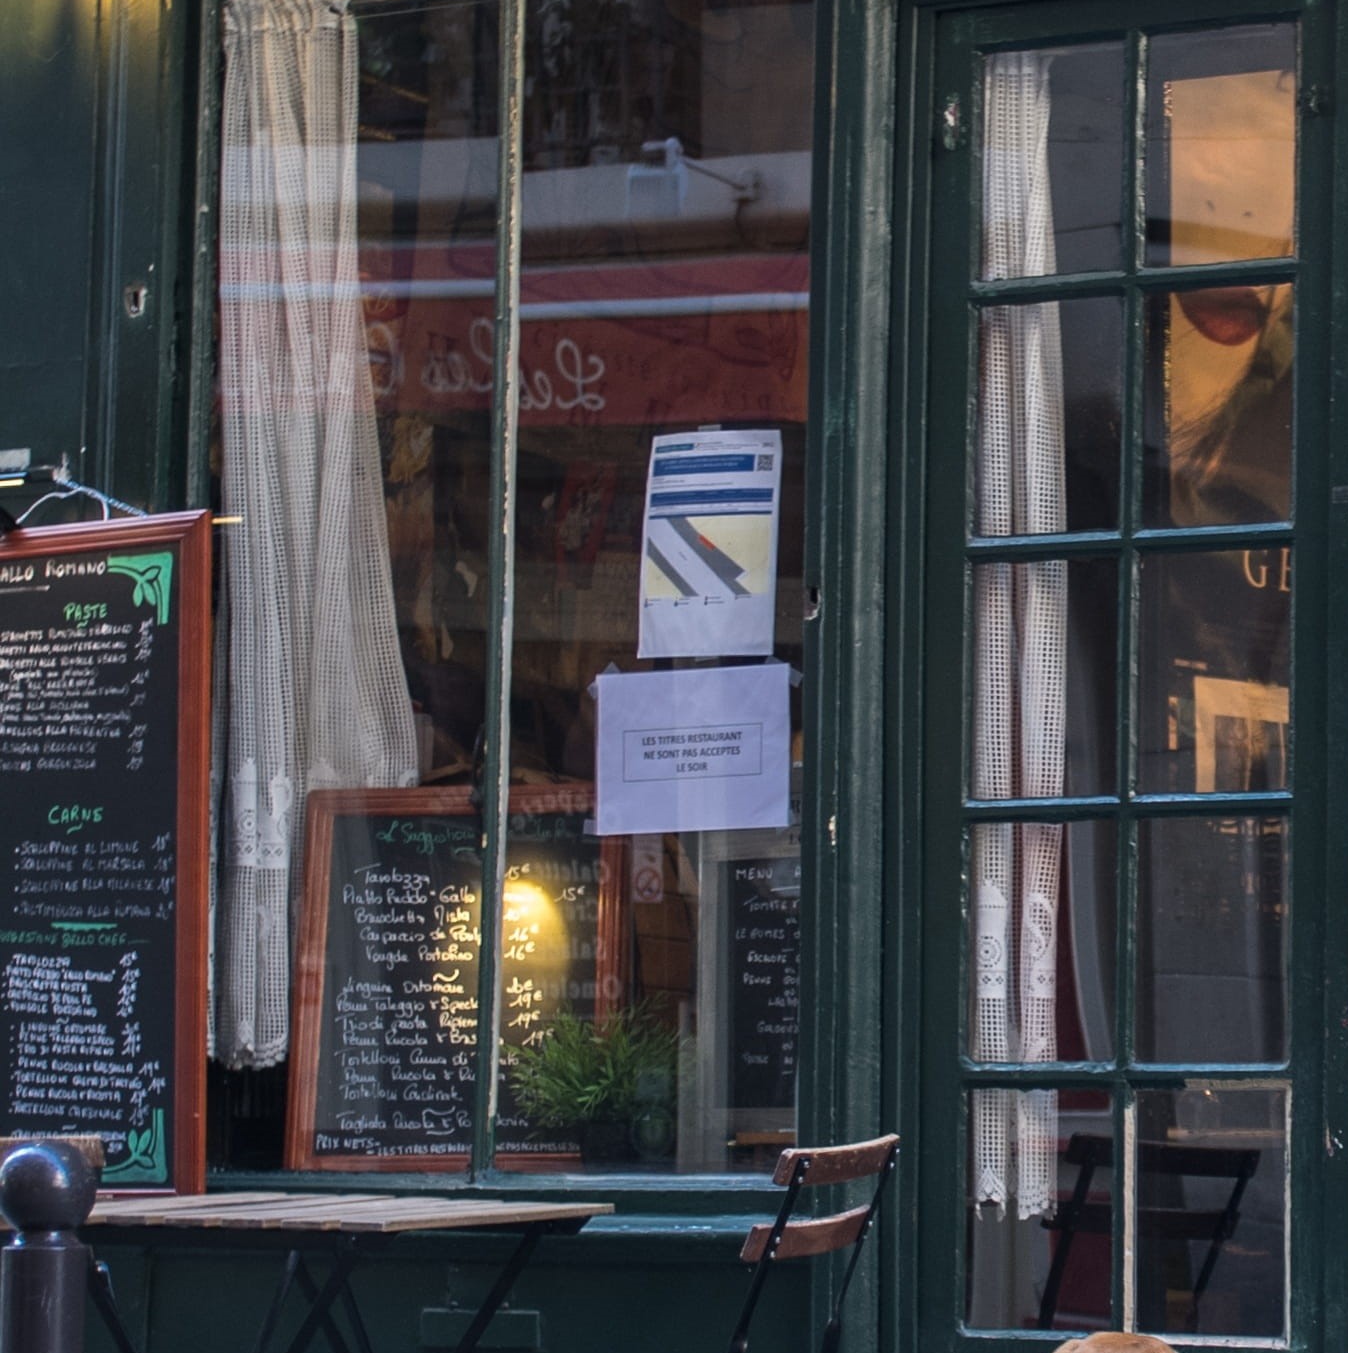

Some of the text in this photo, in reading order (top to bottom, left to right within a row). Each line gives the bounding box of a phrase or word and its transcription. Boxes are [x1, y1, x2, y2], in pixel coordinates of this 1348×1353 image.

[45, 560, 106, 578] ROMANO
[63, 602, 109, 622] PASTE
[642, 731, 742, 746] LES TITRES RESTAURANT
[643, 746, 741, 760] NE SONT PAS ACCEPTES
[676, 762, 708, 773] LE SOIR
[48, 805, 104, 824] CARNE
[736, 868, 773, 881] MENU
